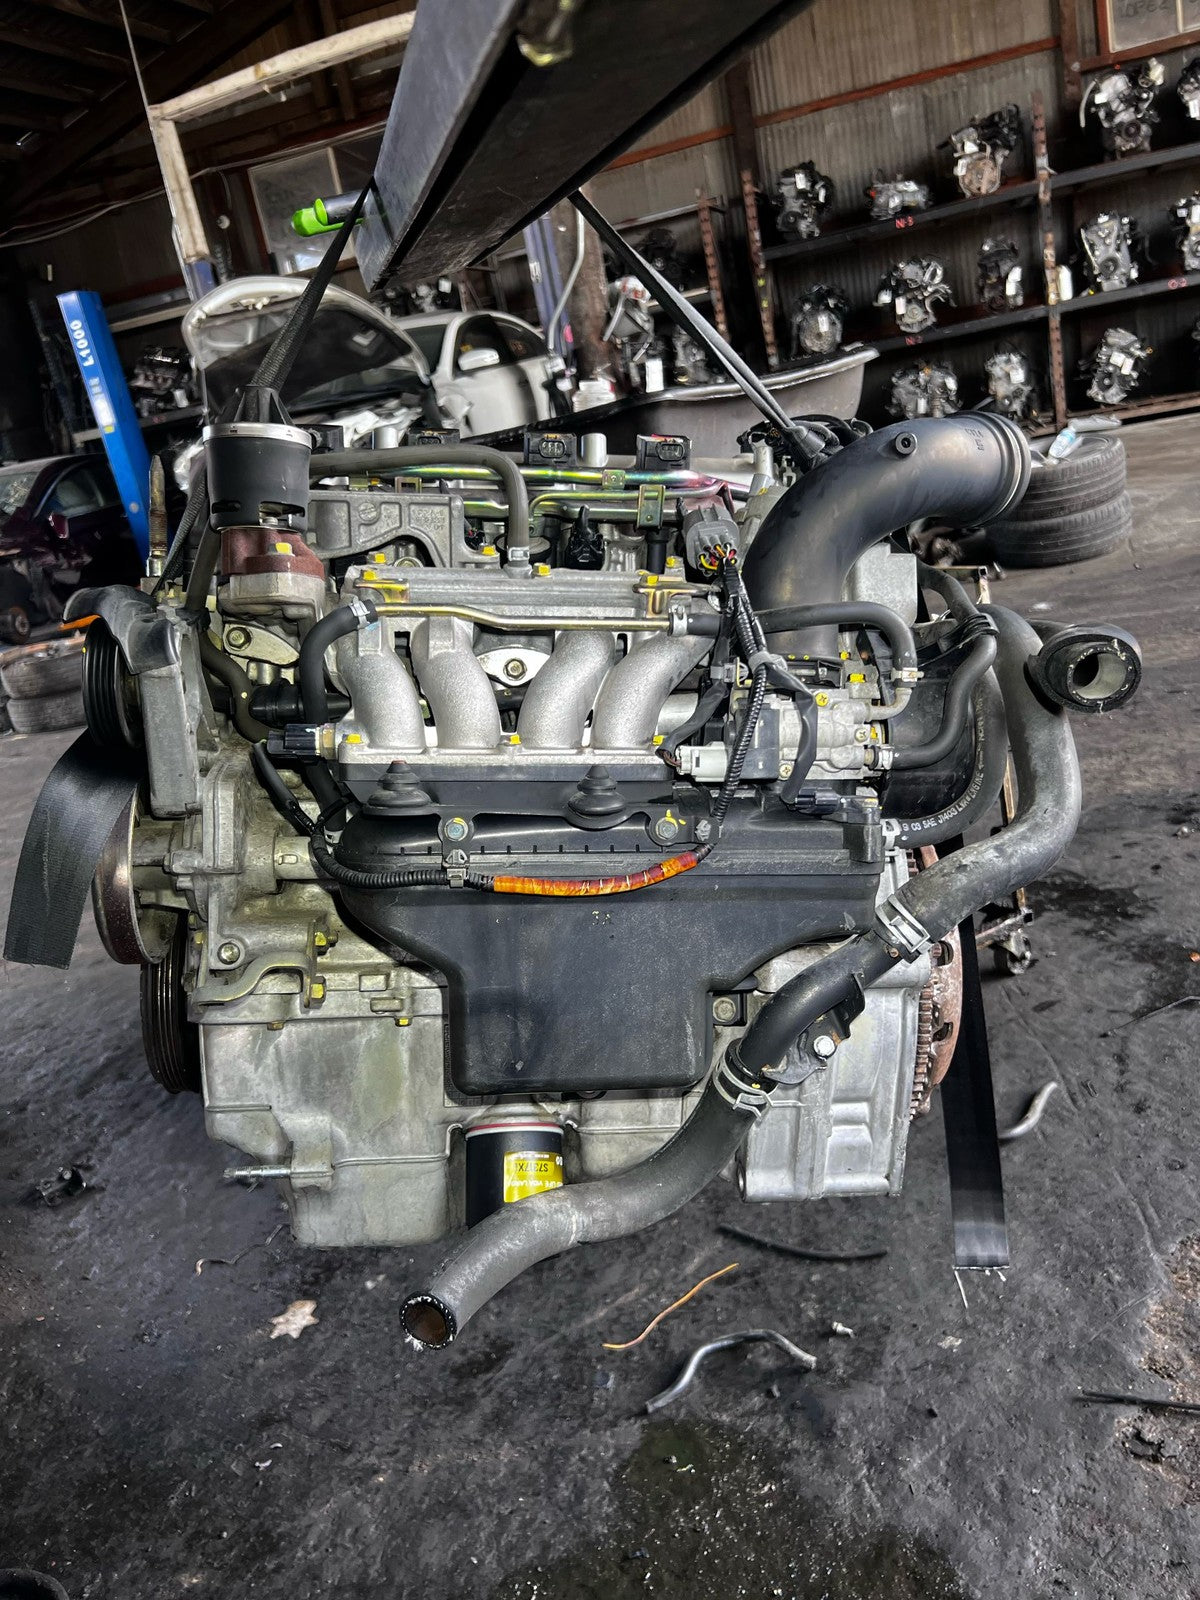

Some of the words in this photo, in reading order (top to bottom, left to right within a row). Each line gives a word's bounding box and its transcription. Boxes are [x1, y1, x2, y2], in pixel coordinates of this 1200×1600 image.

[922, 816, 938, 829] SAE
[938, 808, 959, 826] J1403
[970, 771, 985, 799] ENGINE
